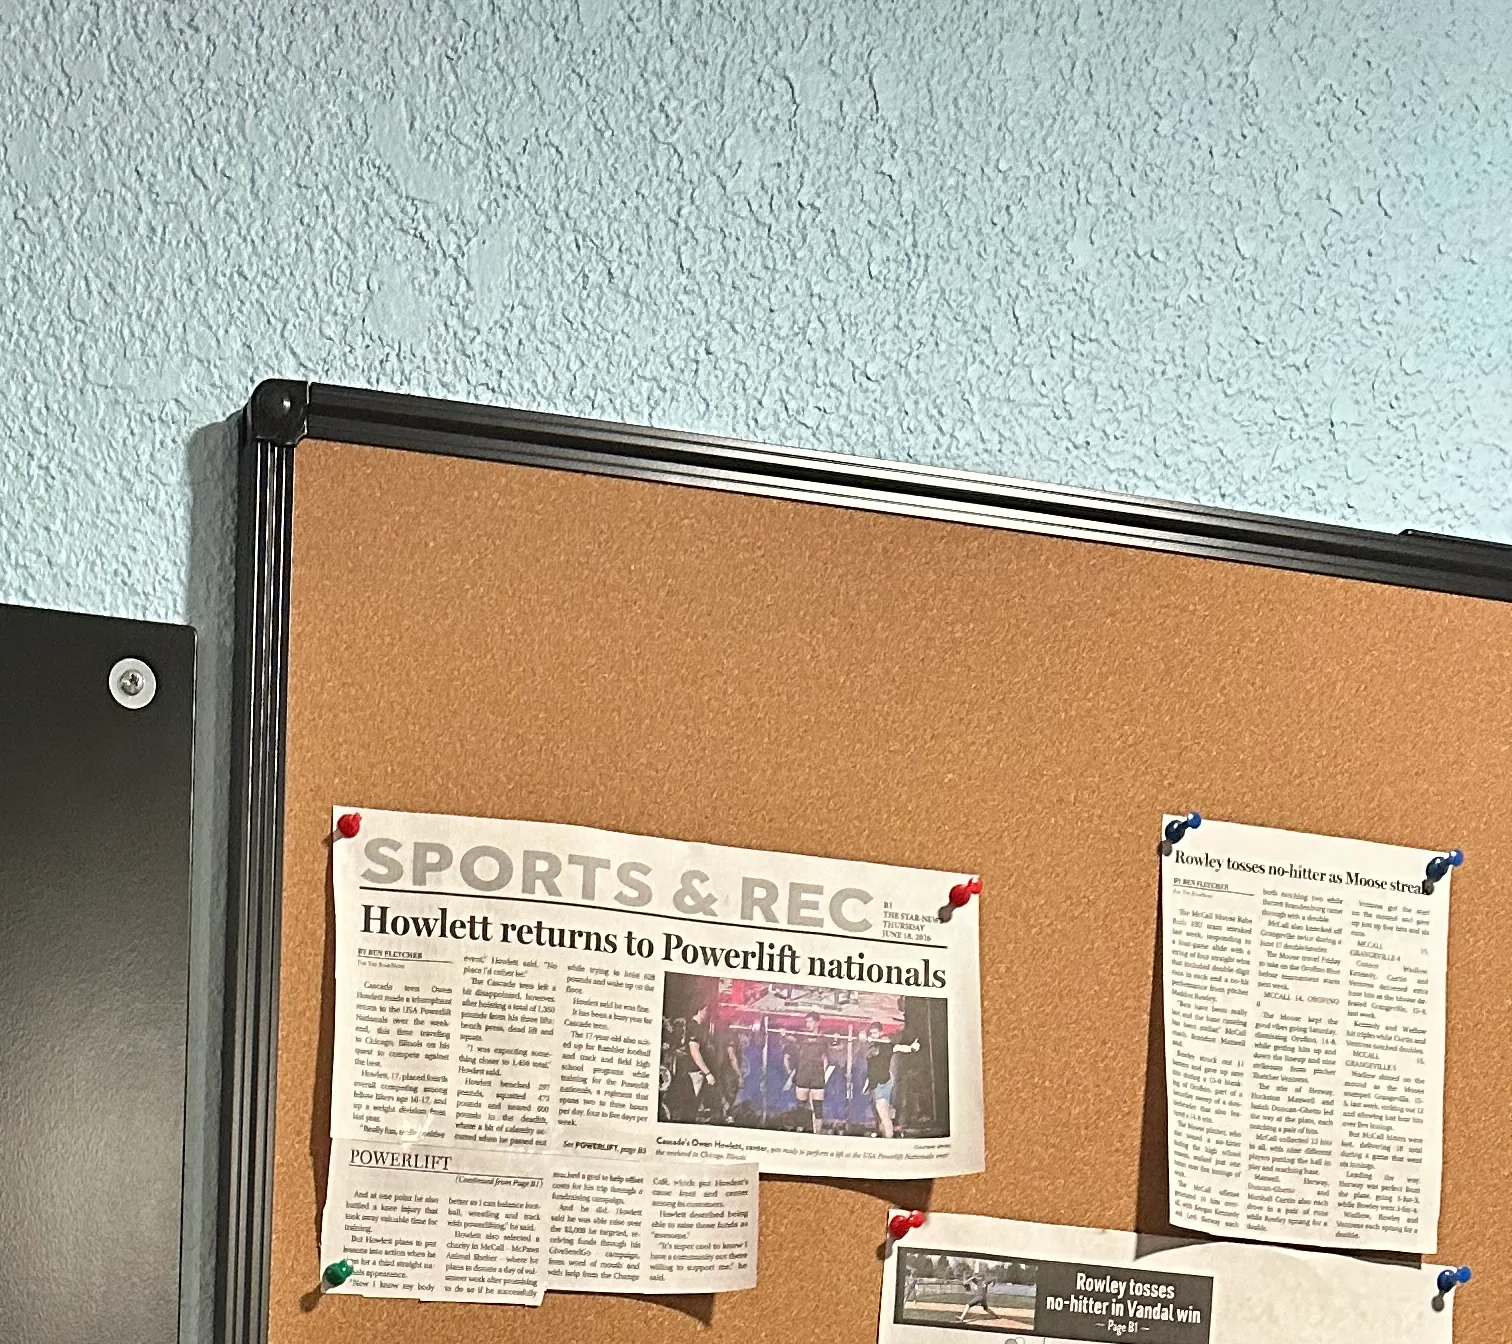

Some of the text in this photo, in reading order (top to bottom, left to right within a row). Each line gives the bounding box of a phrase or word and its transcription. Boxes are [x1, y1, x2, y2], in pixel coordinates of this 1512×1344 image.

[1175, 849, 1222, 873] Rowley
[1227, 857, 1265, 875] tosses
[1269, 864, 1326, 882] no-hitter
[1329, 873, 1343, 884] as
[1345, 871, 1388, 890] Moose
[359, 836, 874, 932] SPORTS & REC
[883, 911, 899, 919] THE
[360, 904, 947, 989] Howlett returns to Powerlift nationals
[692, 1137, 713, 1148] Owen
[350, 1149, 453, 1171] POWERLIFT
[1075, 1272, 1175, 1299] Rowley tosses
[1046, 1295, 1201, 1324] no-hitter in Vandal win
[1107, 1320, 1139, 1336] Page B1
